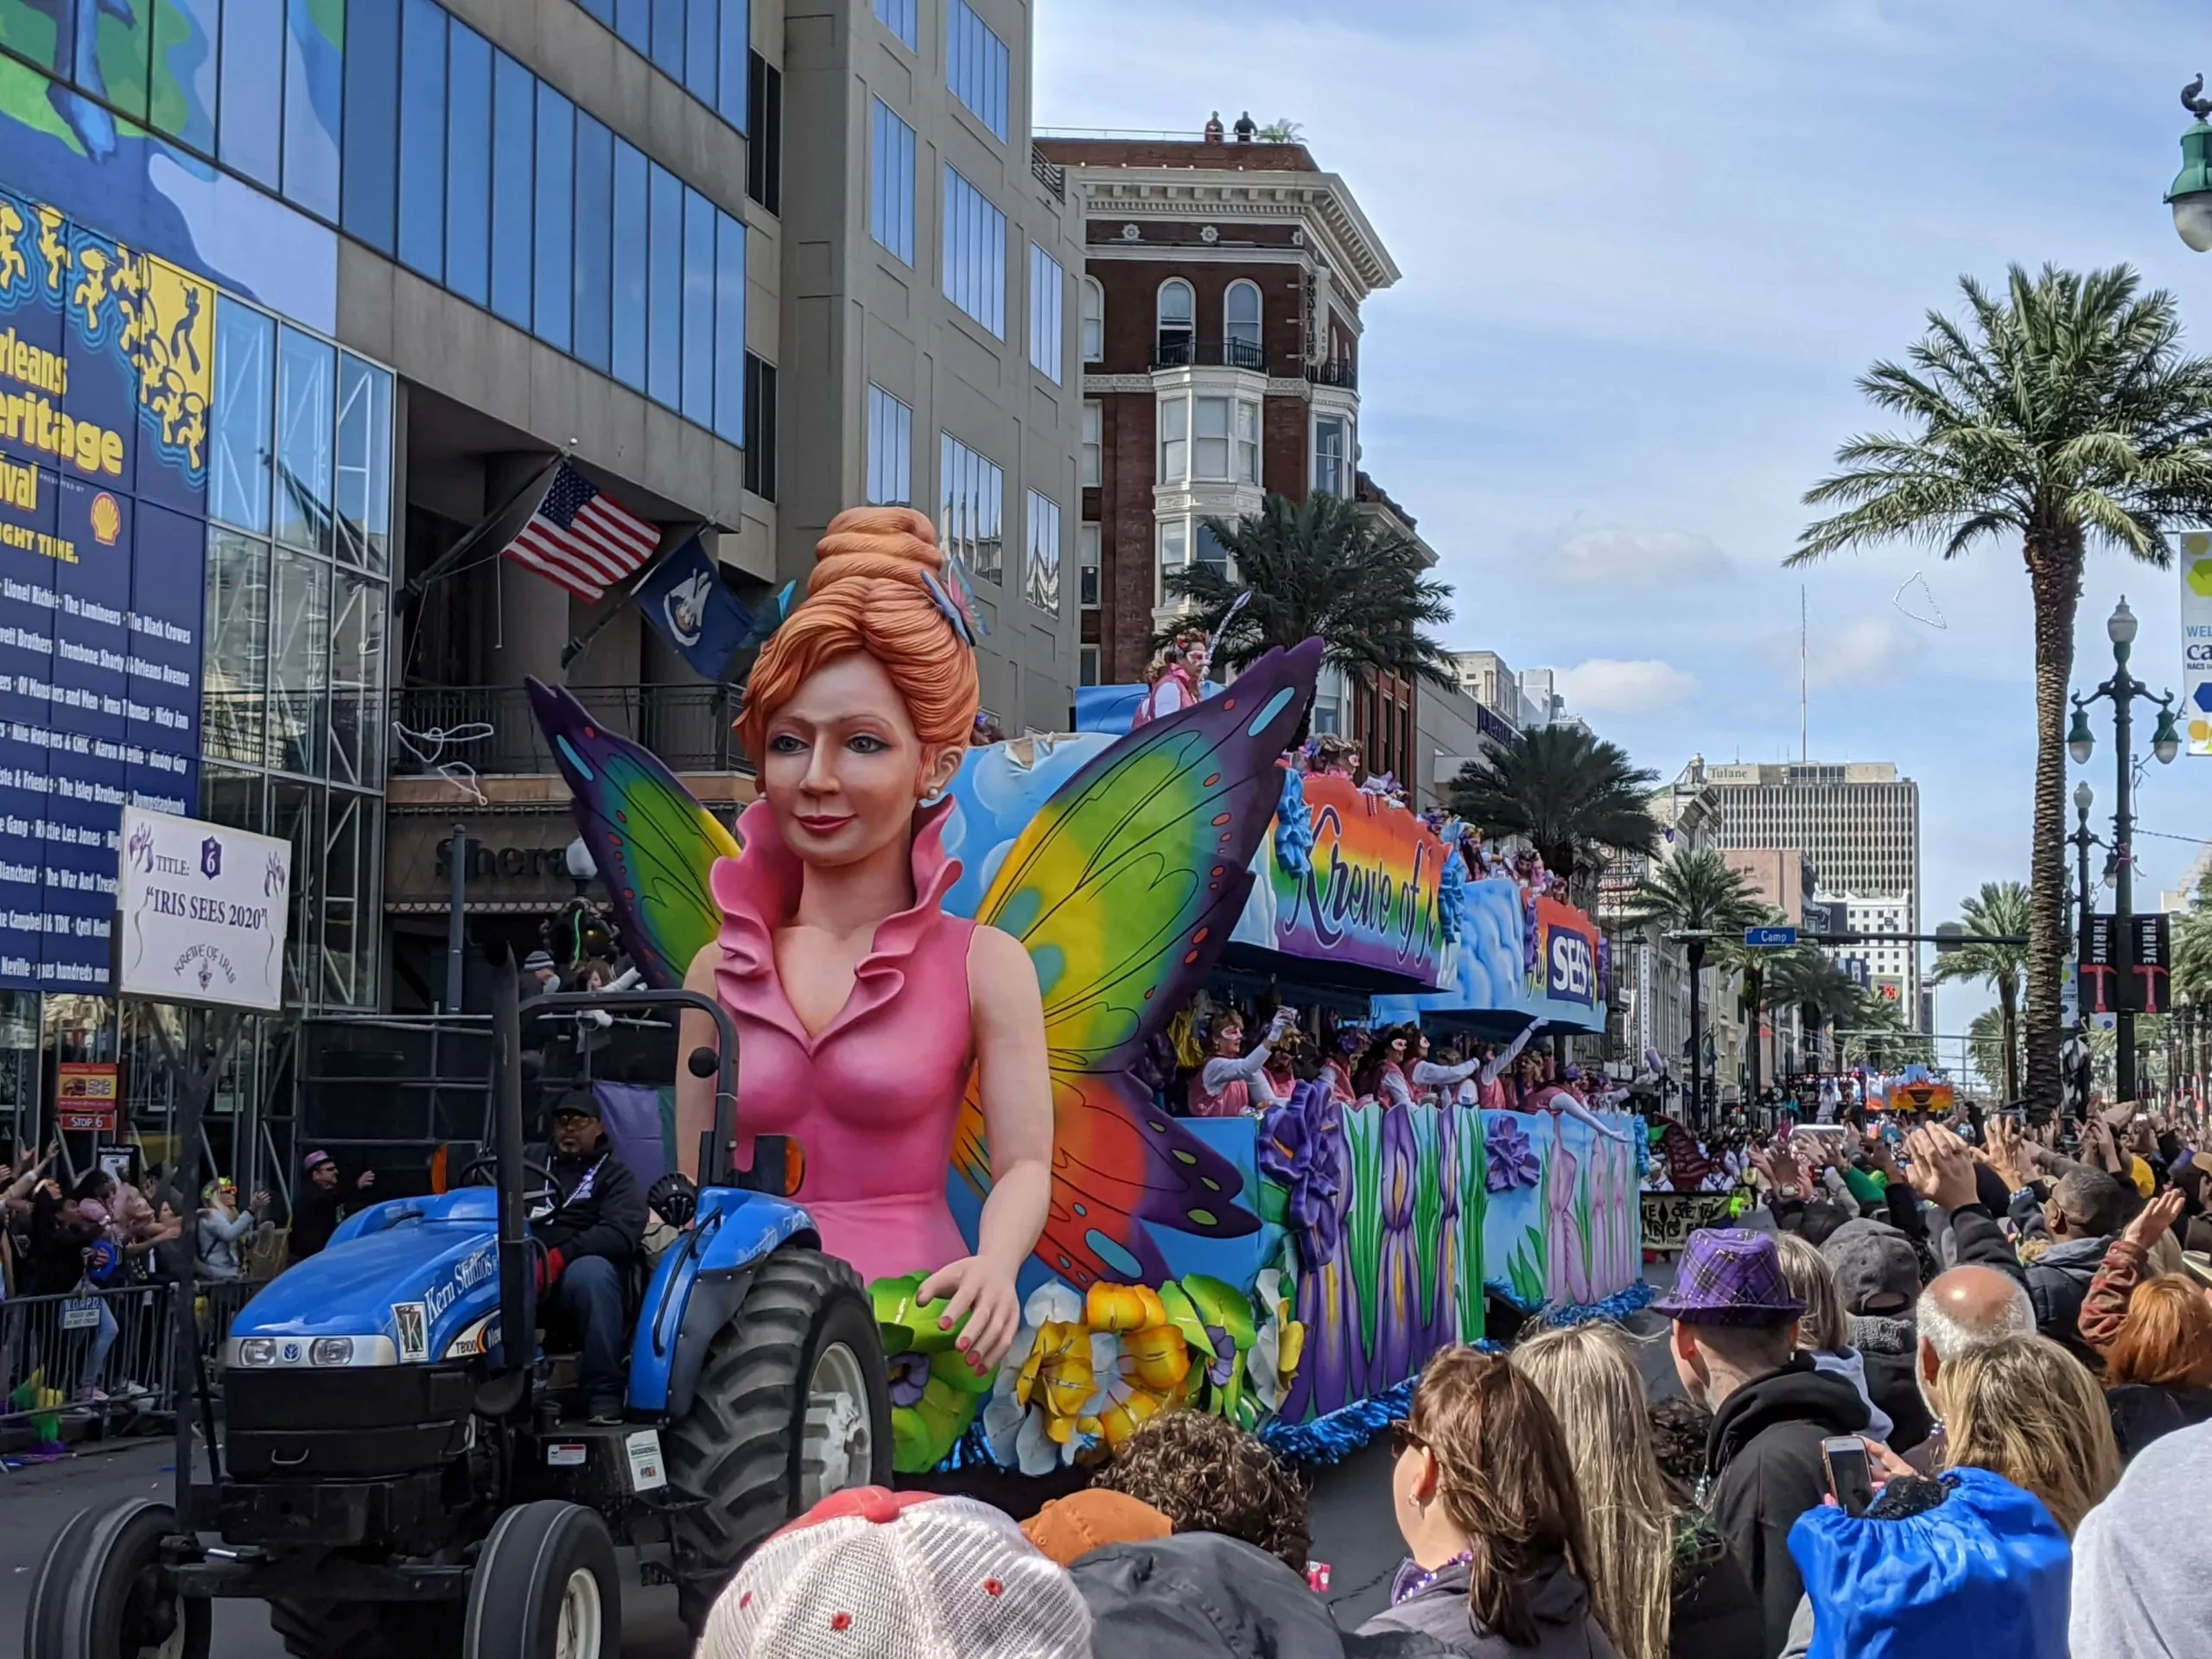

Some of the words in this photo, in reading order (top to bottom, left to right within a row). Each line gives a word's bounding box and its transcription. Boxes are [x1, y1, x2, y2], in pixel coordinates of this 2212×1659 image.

[37, 533, 79, 564] TIME.
[3, 578, 30, 602] Lionel
[64, 594, 79, 615] The
[81, 598, 121, 626] Lumineers
[143, 615, 163, 638] Black
[165, 621, 191, 645] Crowes
[17, 628, 53, 655] Brothers
[60, 639, 99, 665] Trombone
[100, 649, 124, 673] Shorty
[134, 657, 162, 680] Orleans
[163, 664, 190, 687] Avenue
[18, 676, 29, 696] Of
[66, 689, 81, 707] and
[81, 689, 99, 710] Men
[104, 694, 121, 715] Irma
[156, 706, 174, 728] Nicky
[175, 709, 188, 730] Jam
[15, 769, 21, 788] &
[23, 770, 54, 794] Friends
[59, 777, 73, 797] The
[75, 779, 93, 802] Isley
[1708, 767, 1747, 779] Tulane
[7, 815, 29, 838] Gang
[62, 823, 77, 843] Lee
[79, 825, 101, 847] Jones
[156, 855, 189, 876] TITLE:
[206, 851, 216, 874] 6
[60, 869, 78, 889] War
[79, 872, 94, 891] And
[1284, 804, 1393, 948] Krewe
[1395, 840, 1424, 964] of
[54, 914, 70, 933] TDK
[190, 896, 225, 925] SEES
[1761, 930, 1787, 944] Camp
[2092, 918, 2107, 963] THRIVE
[2141, 918, 2158, 963] THRIVE
[2, 955, 30, 977] Neville
[56, 960, 92, 982] hundreds
[207, 944, 219, 961] OF
[219, 953, 237, 984] IRIS
[71, 1116, 92, 1127] STOP
[95, 1116, 103, 1127] 6
[424, 1281, 456, 1325] Kern
[454, 1254, 493, 1295] Studios
[404, 1313, 423, 1351] K
[455, 1340, 477, 1354] TB100
